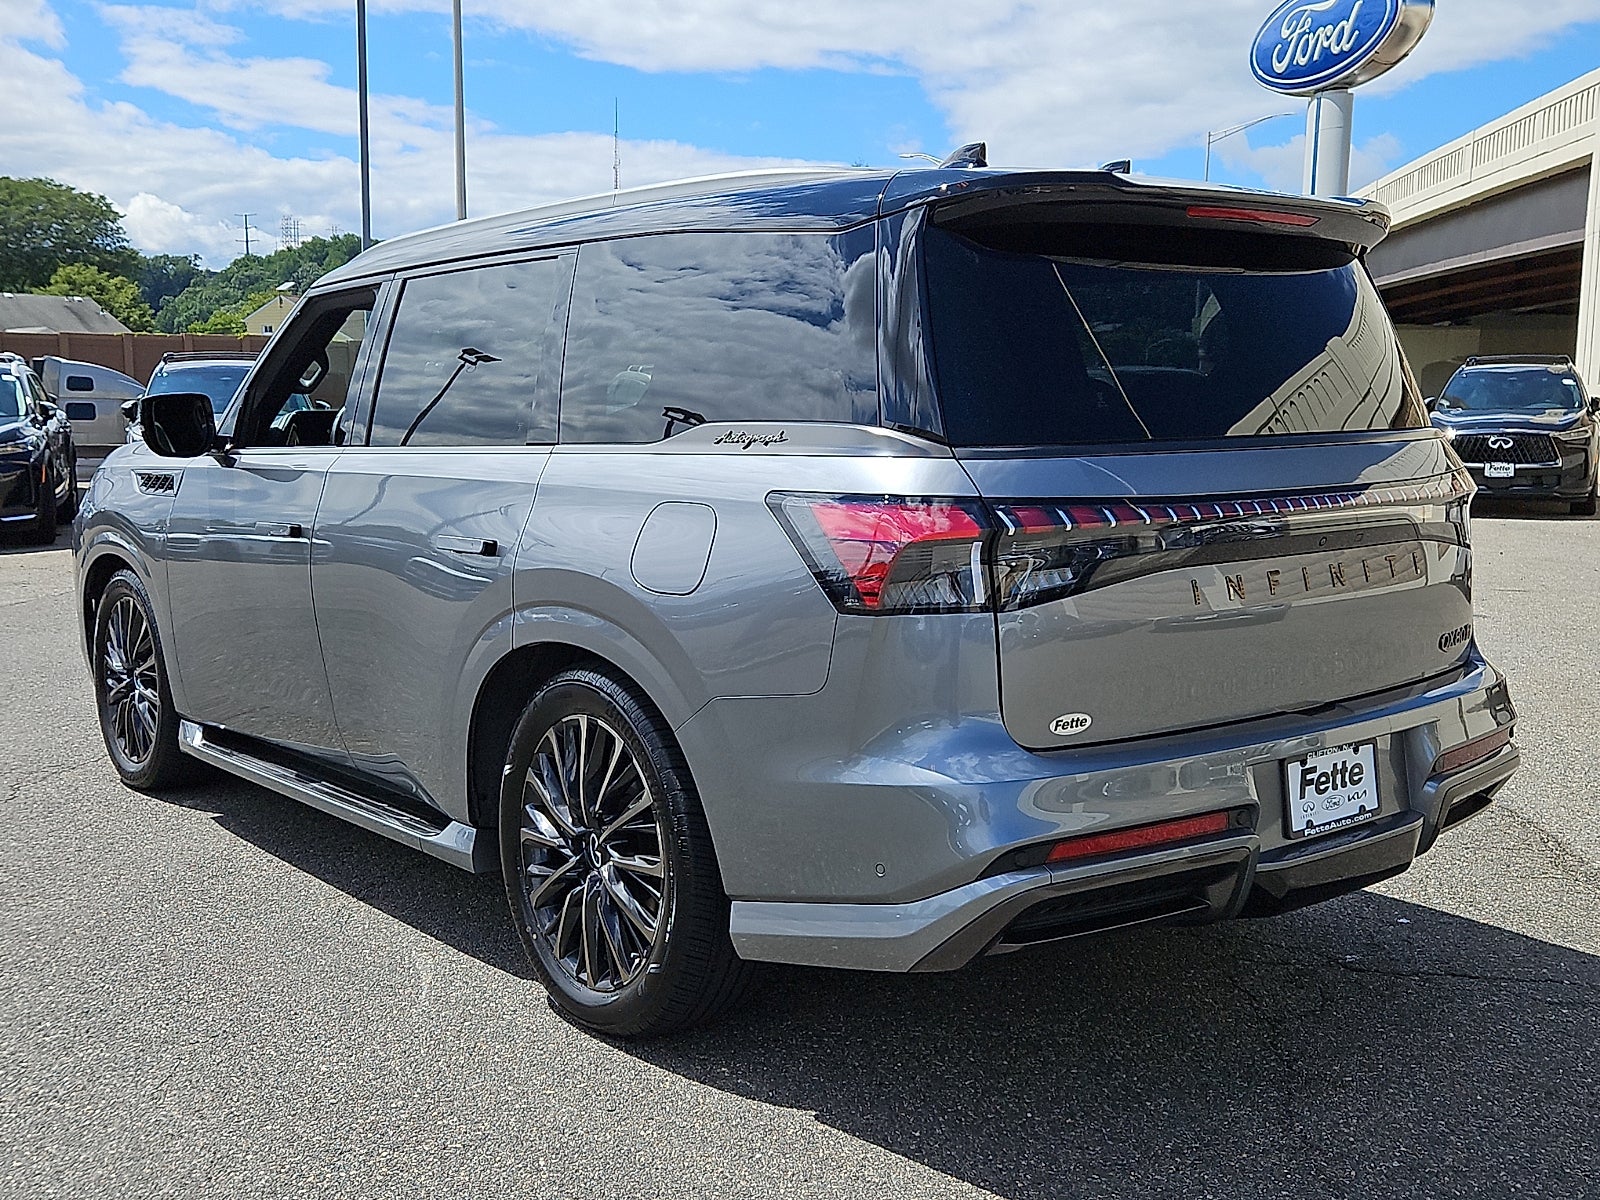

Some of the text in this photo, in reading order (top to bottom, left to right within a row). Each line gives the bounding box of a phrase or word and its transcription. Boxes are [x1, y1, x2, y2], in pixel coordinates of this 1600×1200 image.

[1272, 0, 1364, 74] Ford
[713, 430, 789, 450] Autograph
[1191, 552, 1421, 605] INFINITI
[1054, 717, 1088, 732] Fette
[1299, 760, 1364, 801] Fette
[1304, 812, 1373, 836] FetteAuto.com
